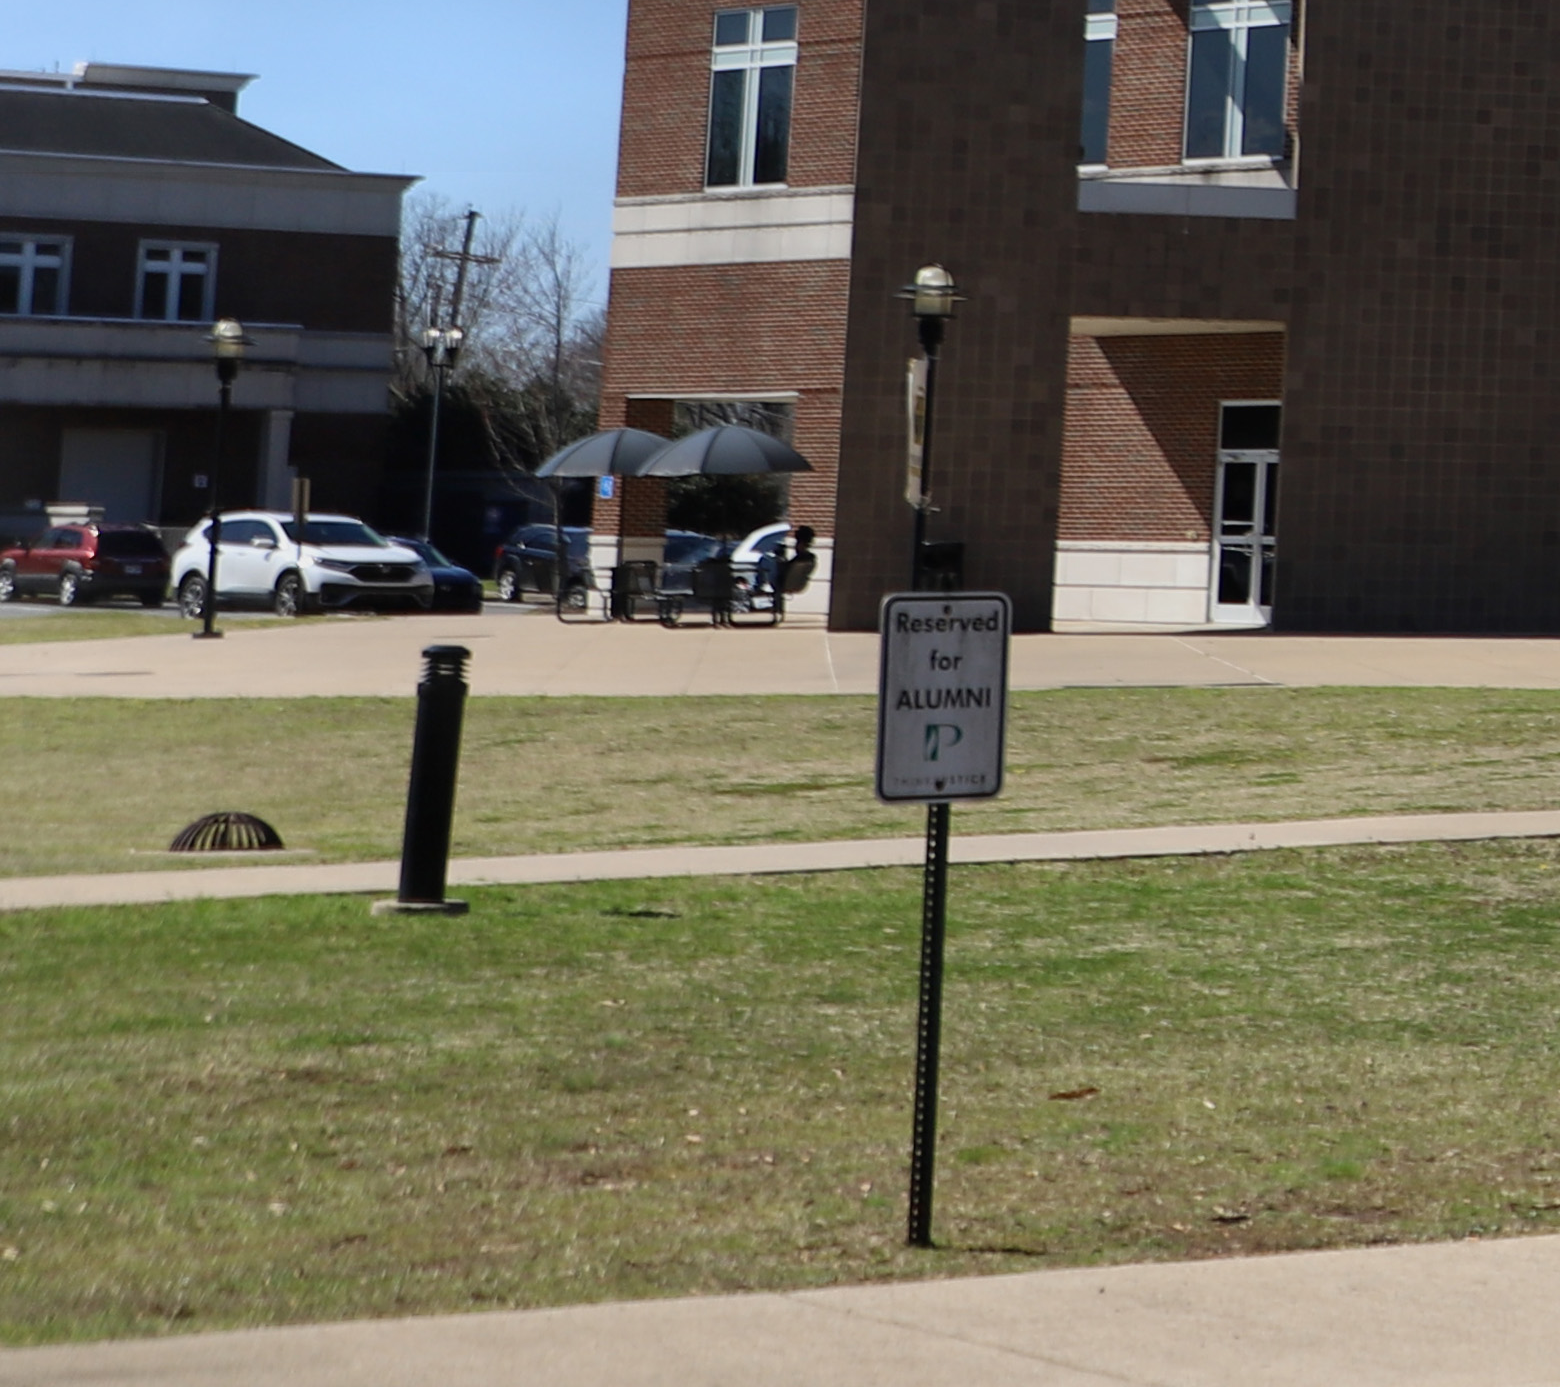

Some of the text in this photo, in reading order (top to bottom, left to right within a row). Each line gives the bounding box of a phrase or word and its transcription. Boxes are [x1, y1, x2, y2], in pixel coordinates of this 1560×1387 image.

[896, 610, 999, 634] Reserved
[930, 649, 963, 671] for
[896, 687, 992, 711] ALUMNI
